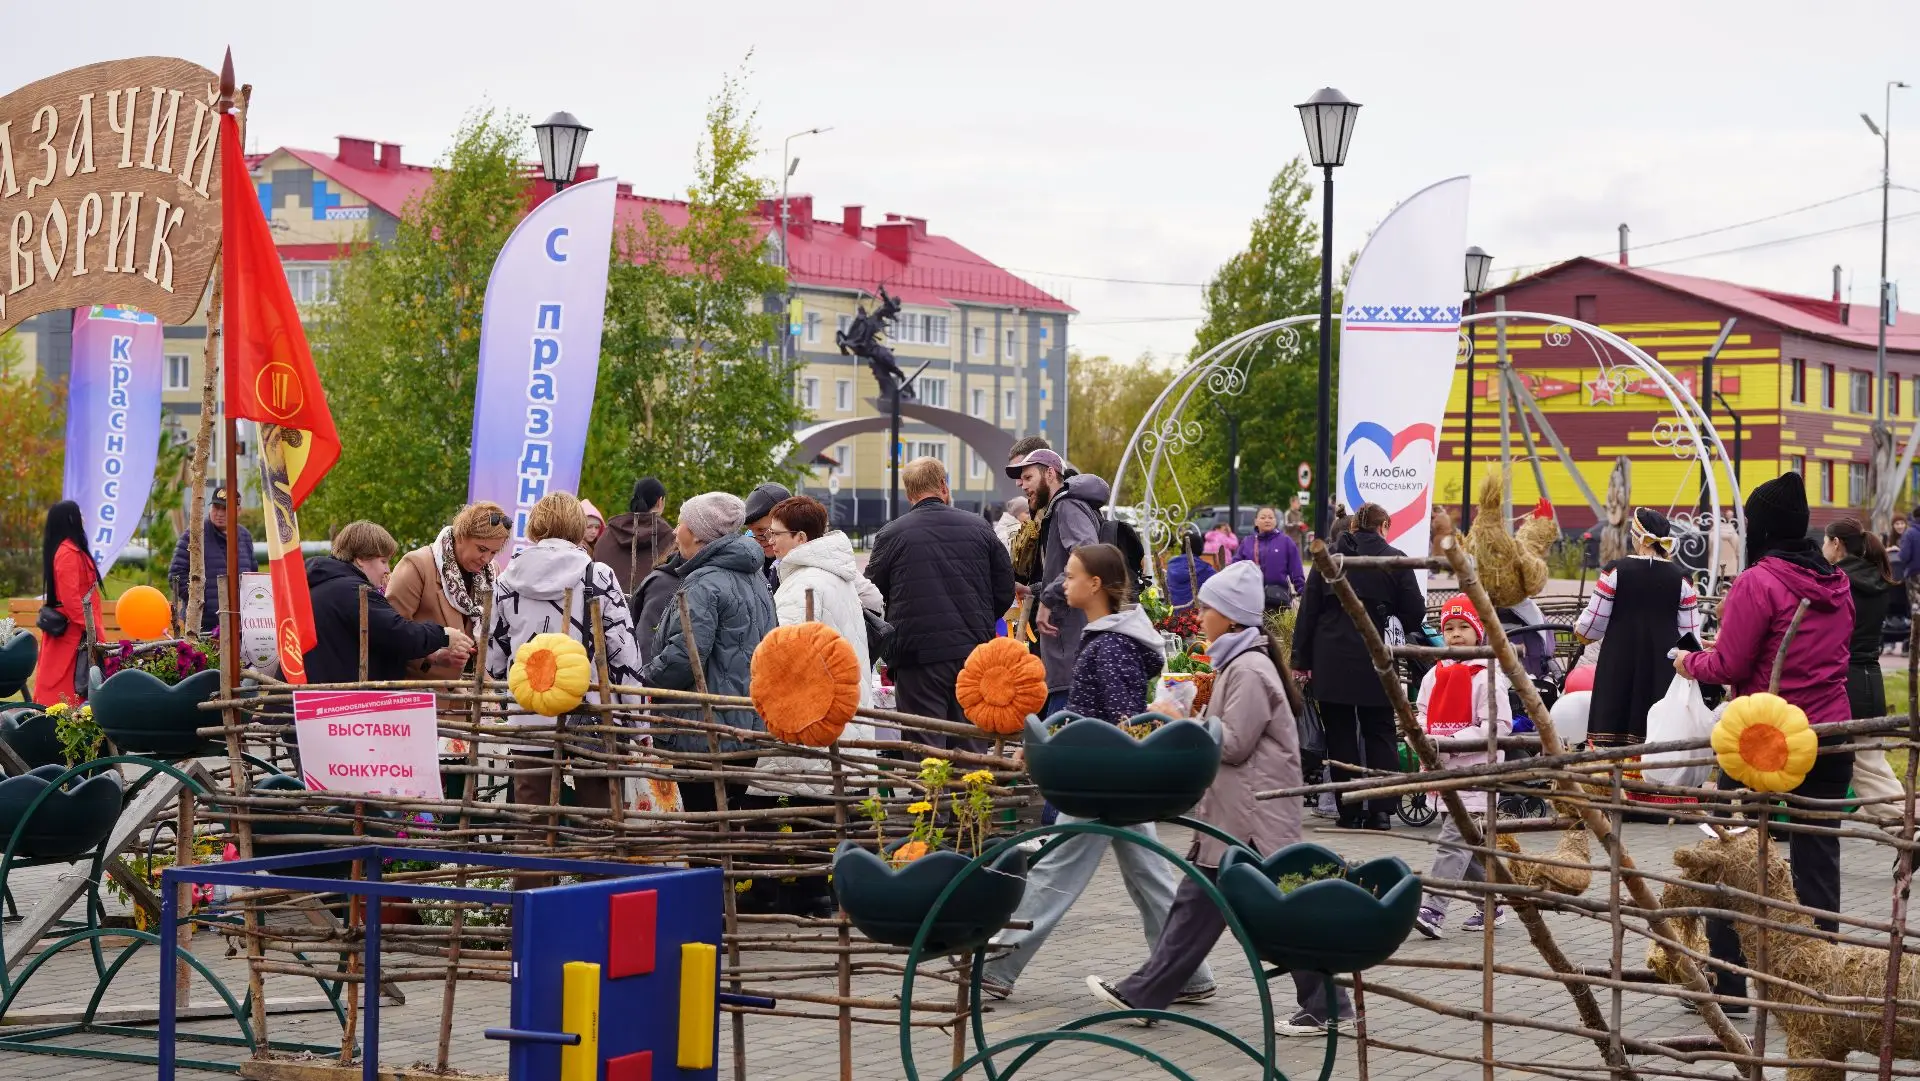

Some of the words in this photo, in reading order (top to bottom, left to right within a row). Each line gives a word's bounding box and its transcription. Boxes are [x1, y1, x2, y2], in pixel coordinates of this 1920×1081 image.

[0, 191, 186, 320] ВОРИК
[515, 304, 562, 553] праздн
[1363, 465, 1369, 477] Я
[323, 699, 392, 714] КРАСНОСЕЛЬКУПСКИЙ
[393, 696, 413, 705] РАЙОН
[328, 723, 411, 737] ВЫСТАВКИ
[328, 763, 413, 778] КОНКУРСЫ
